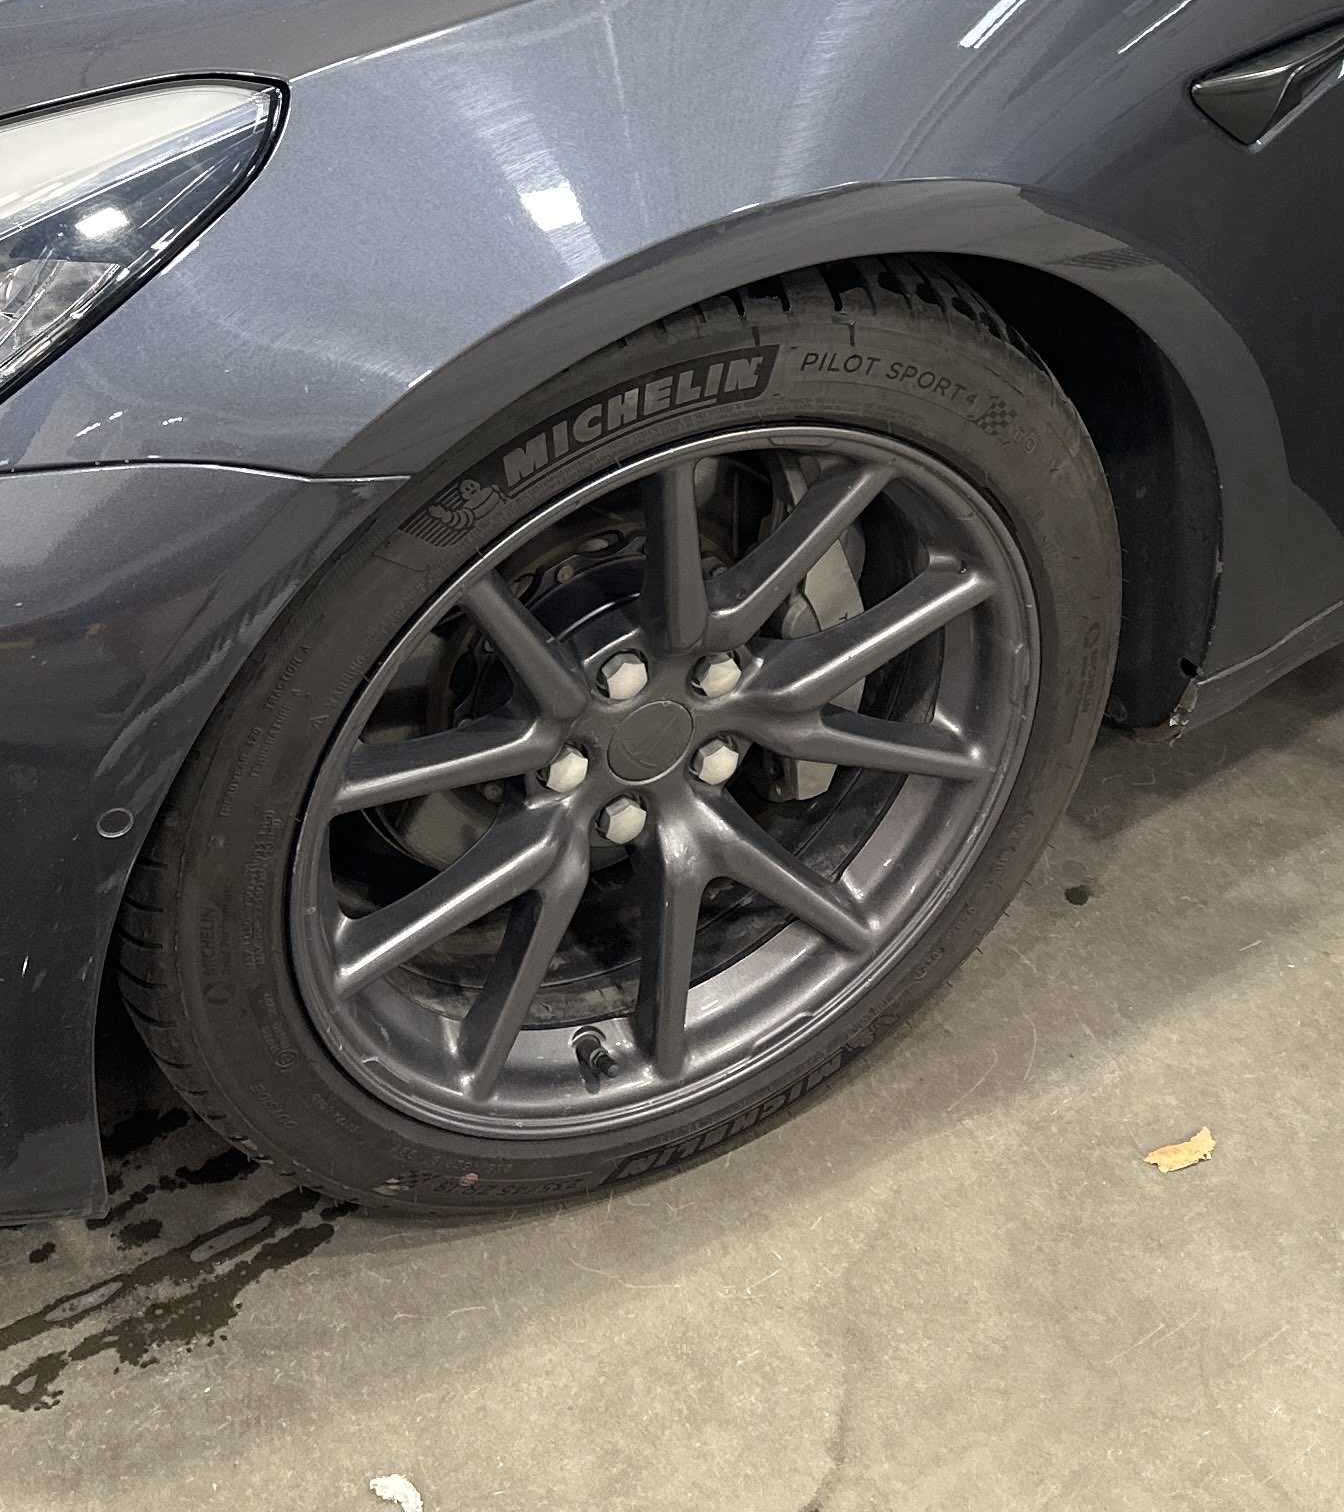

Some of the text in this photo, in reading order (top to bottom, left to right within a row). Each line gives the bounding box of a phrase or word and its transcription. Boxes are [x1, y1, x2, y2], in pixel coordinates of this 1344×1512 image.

[502, 355, 763, 487] MICHELIN
[800, 352, 978, 406] PILOT SPORT 4
[200, 906, 217, 976] MICHELIN
[618, 1053, 841, 1179] MICHELIN
